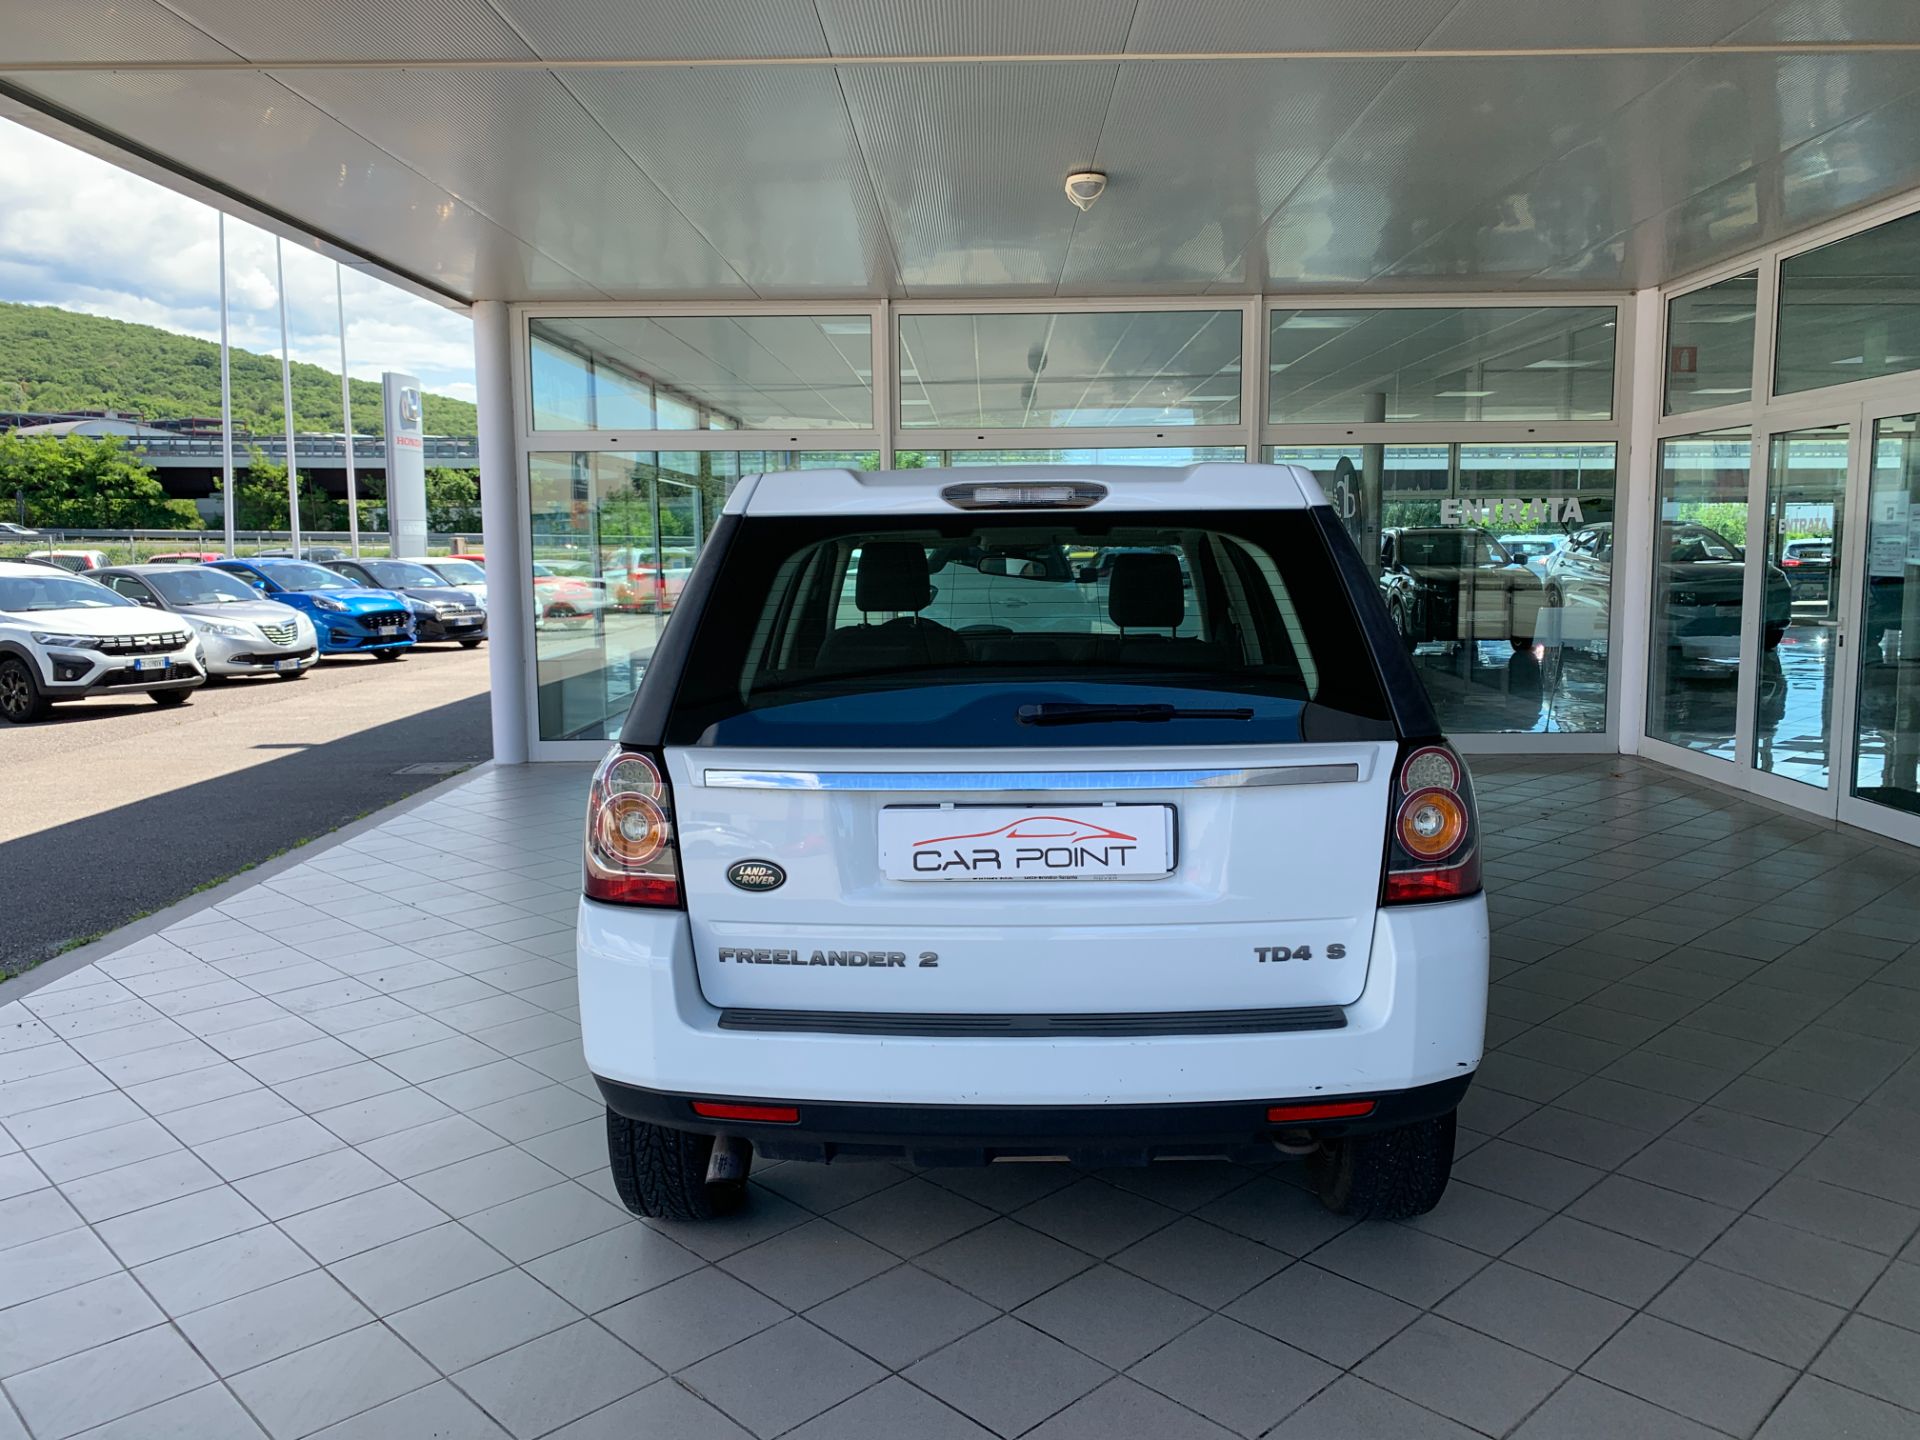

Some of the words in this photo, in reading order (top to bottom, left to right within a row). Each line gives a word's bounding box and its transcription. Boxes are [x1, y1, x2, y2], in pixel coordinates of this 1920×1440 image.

[396, 436, 422, 448] HOND
[1440, 497, 1585, 525] ENTRATA
[1778, 517, 1829, 535] ENTRATA
[913, 849, 1002, 872] CAR
[1015, 846, 1137, 869] POINT
[718, 947, 906, 968] FREELANDER
[918, 951, 939, 968] 2
[1253, 944, 1313, 963] TD4
[1326, 943, 1346, 960] S
